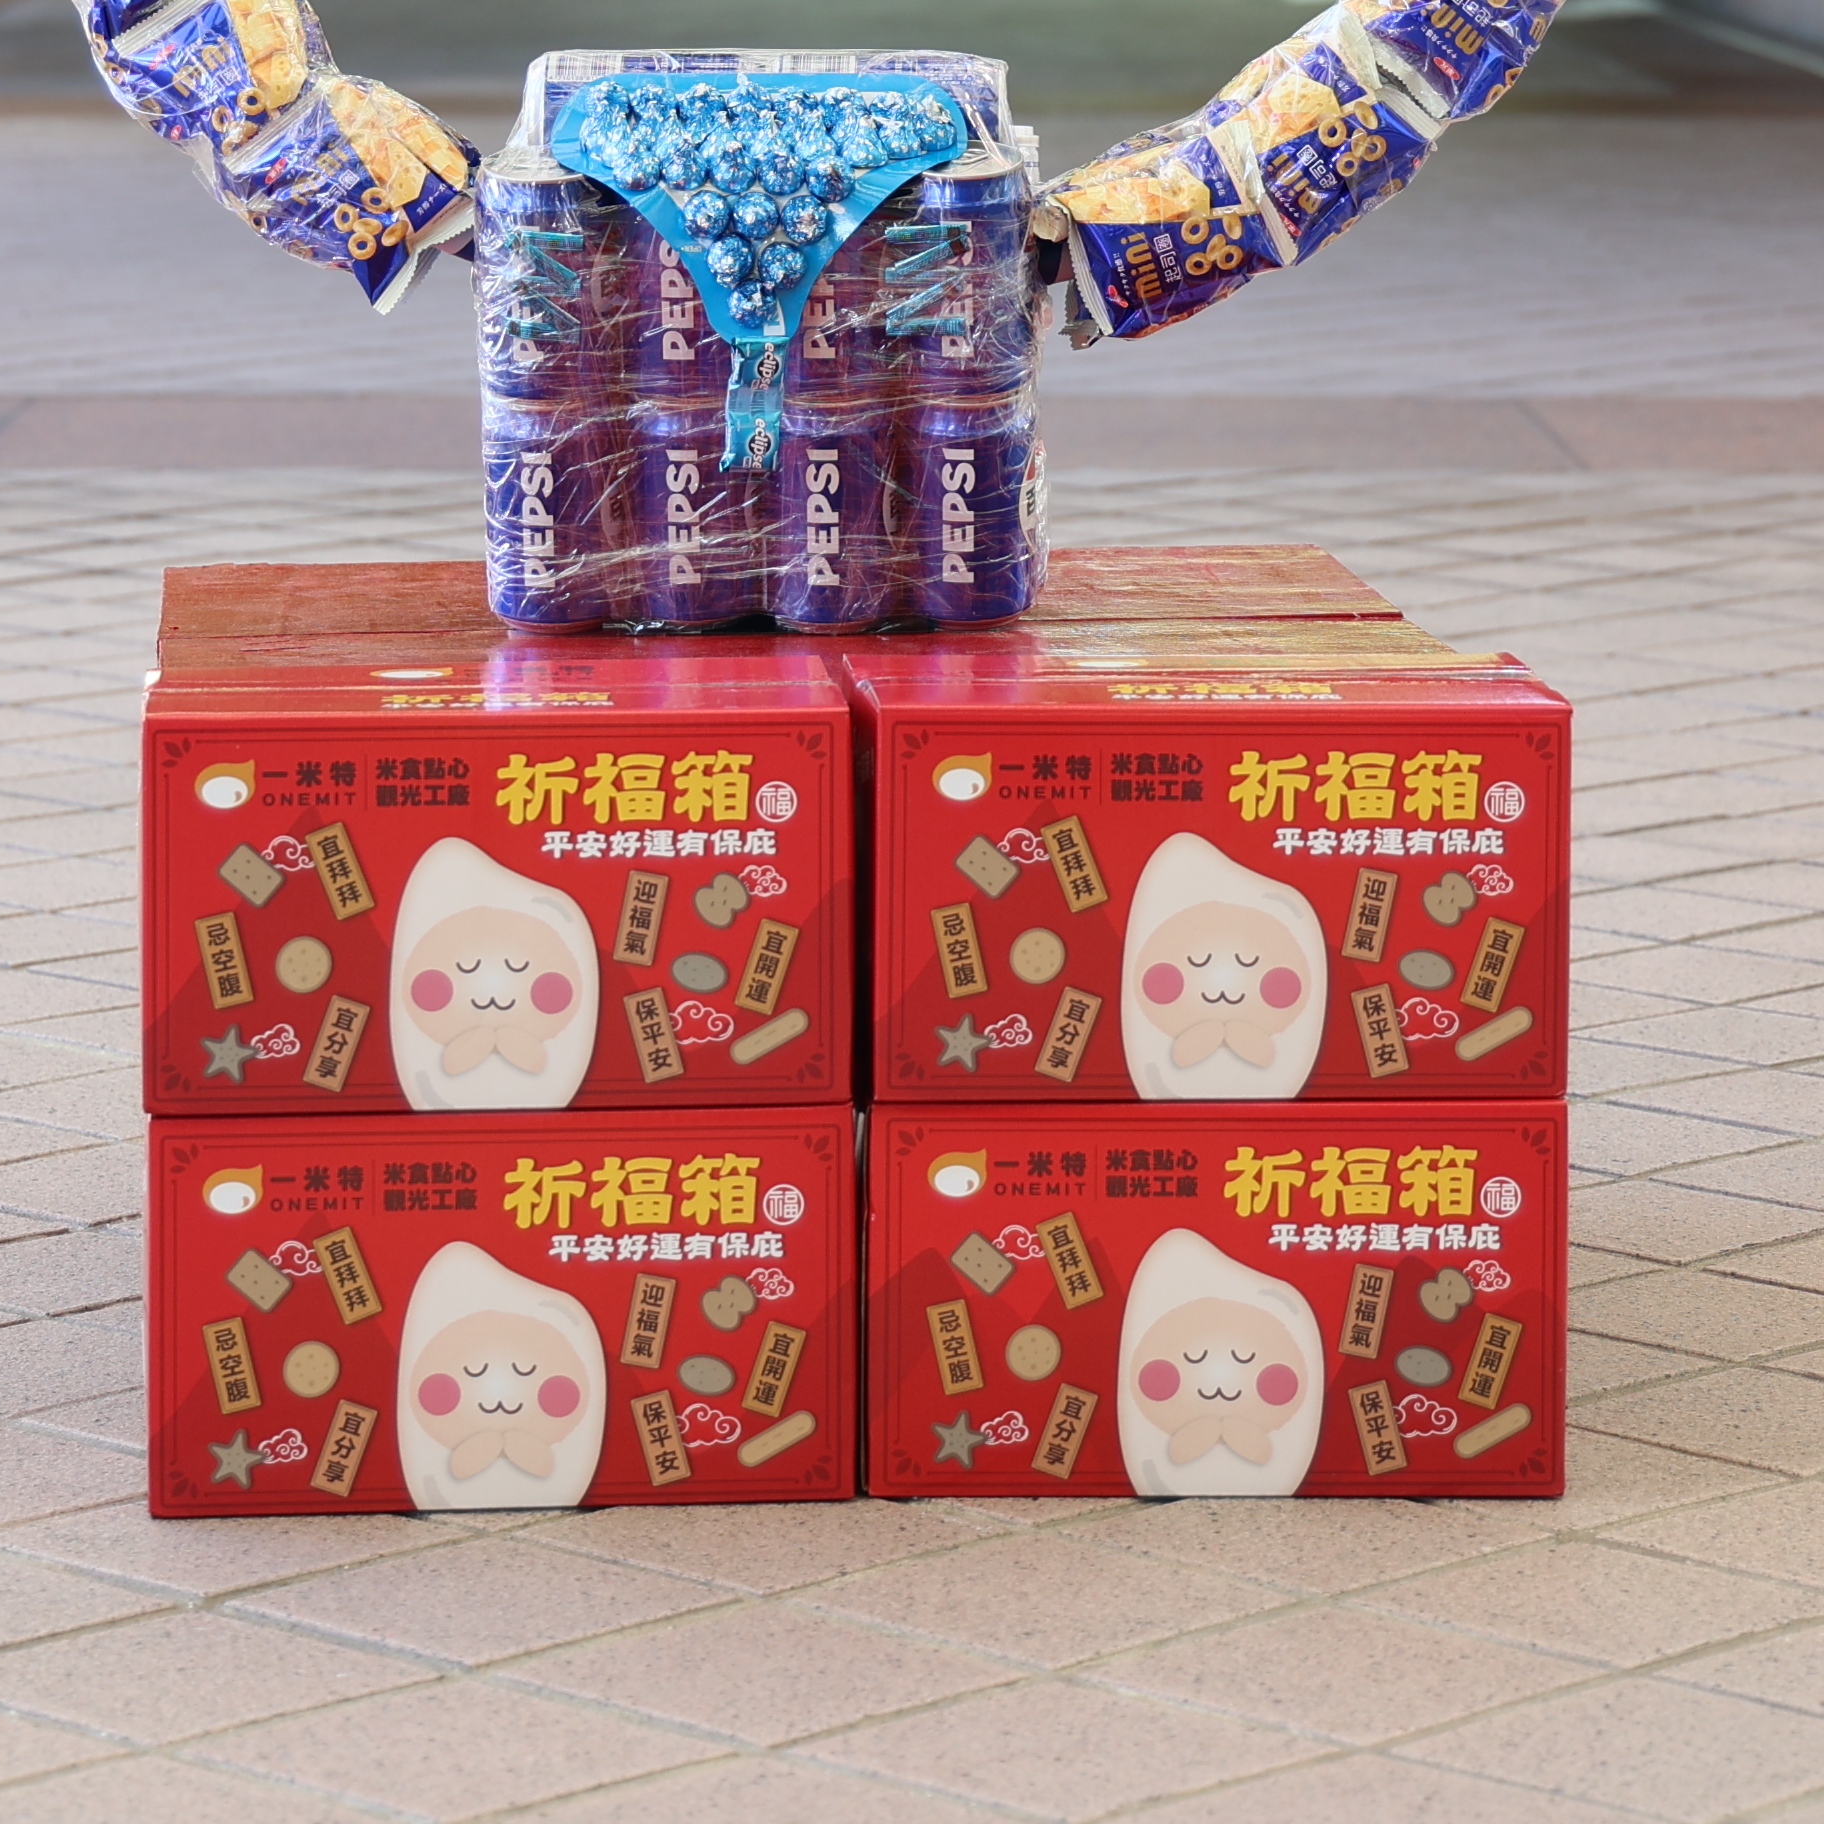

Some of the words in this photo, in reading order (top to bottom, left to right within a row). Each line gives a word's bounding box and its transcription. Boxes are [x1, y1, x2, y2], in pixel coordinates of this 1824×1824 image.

[1267, 152, 1323, 214] mini
[1120, 232, 1163, 299] mini
[1153, 233, 1182, 283] 起司圈
[659, 239, 695, 360] PEPS
[759, 342, 777, 390] eclipse
[751, 418, 768, 468] eclipse
[520, 451, 556, 588] PEPSI
[665, 449, 702, 585] PEPSI
[805, 448, 840, 586] PEPSI
[941, 447, 975, 583] PEPSI
[262, 760, 357, 787] 一米特
[262, 793, 356, 807] ONEMIT
[495, 750, 754, 825] 祈福箱
[762, 787, 792, 817] 福
[998, 755, 1092, 780] 一米特
[998, 785, 1092, 800] ONEMIT
[1228, 749, 1483, 822] 祈福箱
[1489, 786, 1519, 817] 福
[316, 834, 362, 907] 宜拜拜
[541, 828, 778, 859] 平安好運有保庇
[1052, 826, 1097, 900] 宜拜拜
[1272, 827, 1504, 856] 平安好運有保庇
[622, 880, 658, 957] 迎福氣
[942, 912, 978, 989] 忌空腹
[1350, 876, 1387, 954] 迎福氣
[206, 922, 241, 998] 忌空腹
[745, 930, 787, 1004] 宜開運
[1472, 928, 1515, 1002] 宜開運
[315, 1005, 356, 1080] 宜分享
[635, 998, 673, 1072] 保平安
[1046, 996, 1090, 1071] 宜分享
[1361, 994, 1399, 1068] 保平安
[271, 1166, 364, 1191] 一米特
[503, 1152, 761, 1230] 祈福箱
[994, 1151, 1086, 1176] 一米特
[994, 1181, 1086, 1196] ONEMIT
[1223, 1144, 1478, 1218] 祈福箱
[1486, 1181, 1516, 1213] 福
[271, 1196, 364, 1212] ONEMIT
[768, 1188, 800, 1220] 福
[1268, 1222, 1501, 1252] 平安好運有保庇
[325, 1237, 369, 1312] 宜拜拜
[548, 1231, 783, 1262] 平安好運有保庇
[1048, 1222, 1093, 1297] 宜拜拜
[630, 1281, 665, 1358] 迎福氣
[938, 1308, 973, 1385] 忌空腹
[1347, 1273, 1383, 1350] 迎福氣
[214, 1327, 250, 1403] 忌空腹
[752, 1333, 794, 1405] 宜開運
[1468, 1324, 1511, 1398] 宜開運
[322, 1410, 363, 1485] 宜分享
[642, 1400, 680, 1474] 保平安
[1043, 1392, 1083, 1467] 宜分享
[1359, 1391, 1396, 1465] 保平安
